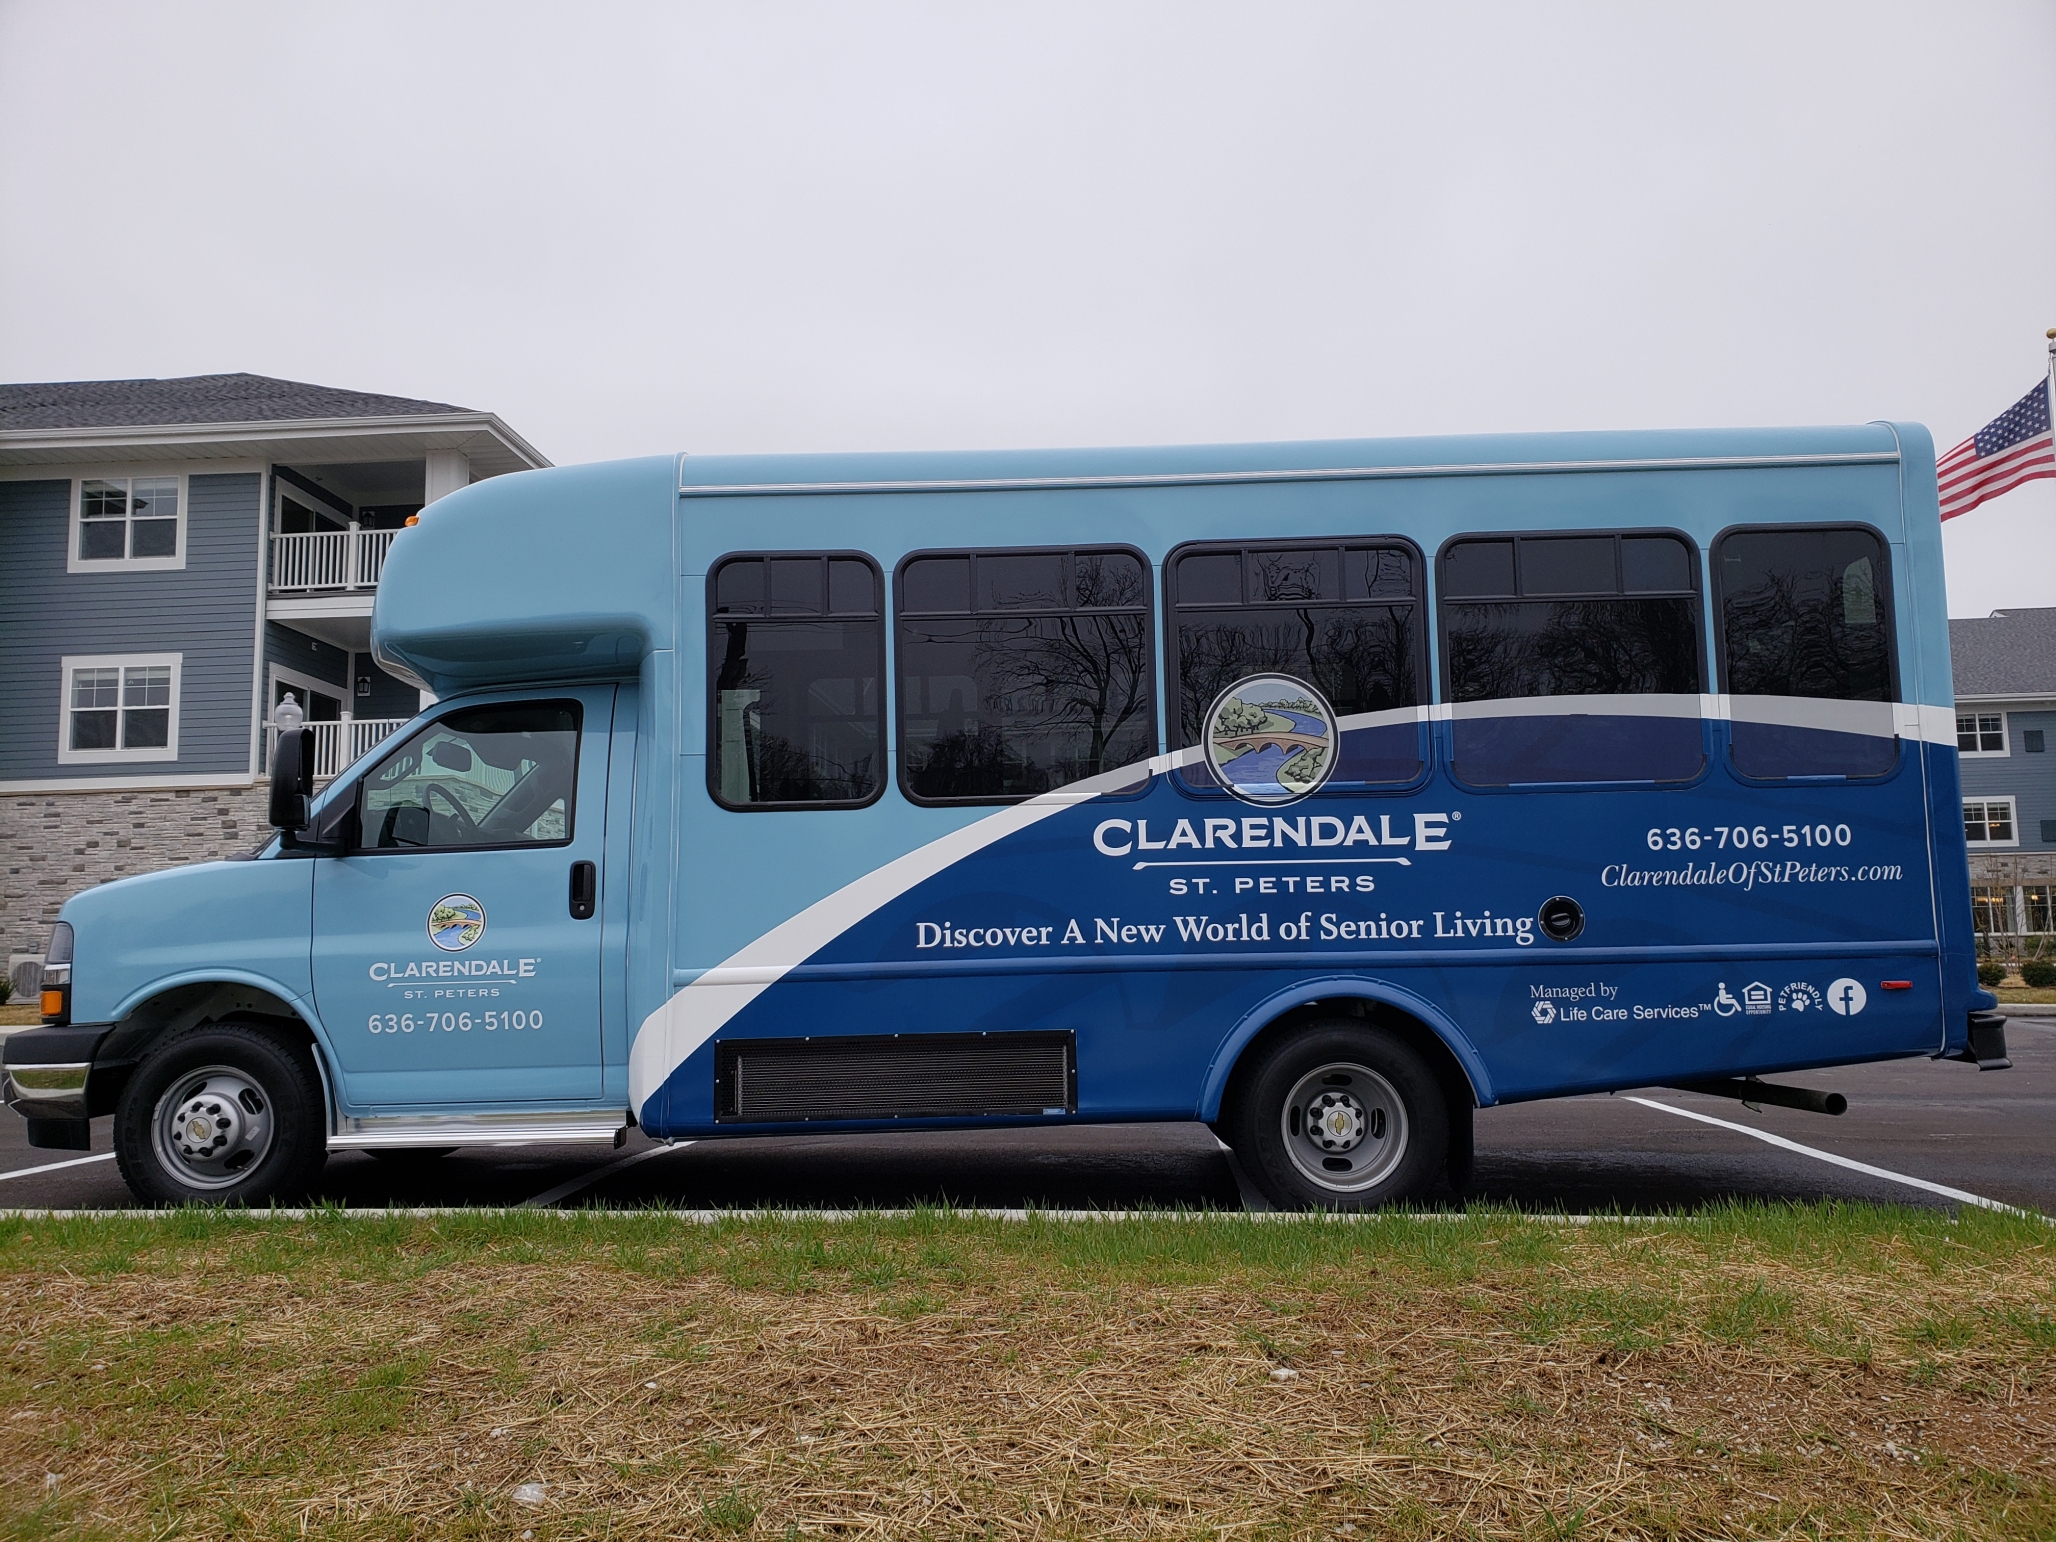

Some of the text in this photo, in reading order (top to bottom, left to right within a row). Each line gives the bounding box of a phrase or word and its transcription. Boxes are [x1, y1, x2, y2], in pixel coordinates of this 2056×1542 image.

[1646, 823, 1852, 851] 636-706-5100
[1169, 875, 1375, 895] ST. PETERS
[1601, 861, 1903, 891] ClarendaleOfStPeters.com
[916, 910, 1535, 948] Discover A New World of Senior Living
[403, 988, 500, 999] ST. PETERS
[1530, 982, 1619, 1002] Managed by
[368, 1010, 543, 1034] 636-706-5100
[1560, 1006, 1588, 1022] Life
[1591, 1006, 1629, 1021] Care
